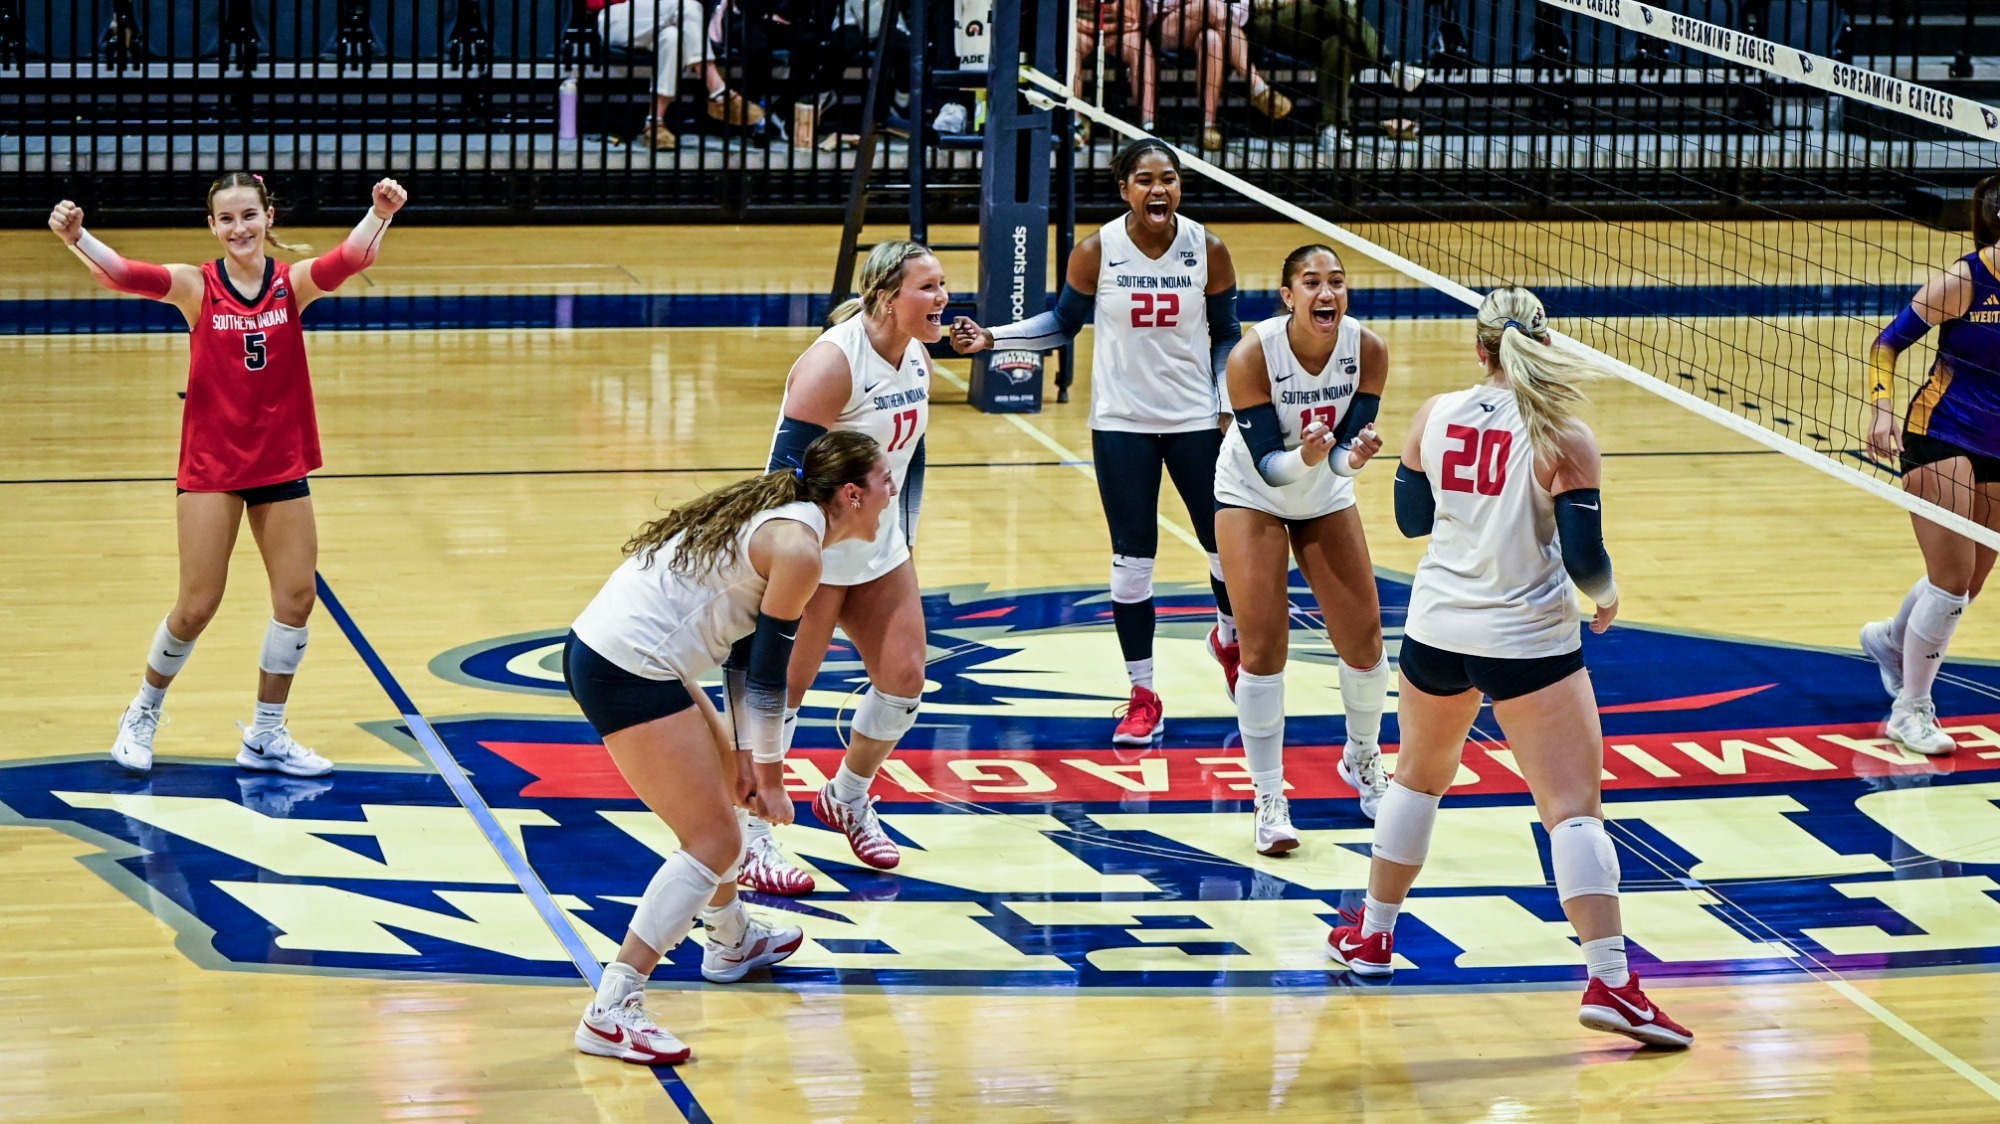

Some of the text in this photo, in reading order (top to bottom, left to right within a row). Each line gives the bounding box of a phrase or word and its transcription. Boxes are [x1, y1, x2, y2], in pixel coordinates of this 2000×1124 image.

[1671, 15, 1775, 65] SCREAMING EAGLES
[960, 55, 984, 64] ADE
[1832, 64, 1953, 120] SCREAMING EAGLES
[1011, 226, 1027, 274] sports
[1116, 275, 1192, 289] SOUTHERN INDIANA
[213, 314, 256, 330] SOUTHERN
[1130, 293, 1180, 328] 22
[243, 331, 267, 371] 5
[1338, 357, 1354, 366] TCG
[874, 392, 904, 411] SOUTHERN
[1281, 383, 1353, 405] SOUTHERN INDIANA
[887, 408, 918, 452] 17
[1441, 423, 1513, 496] 20
